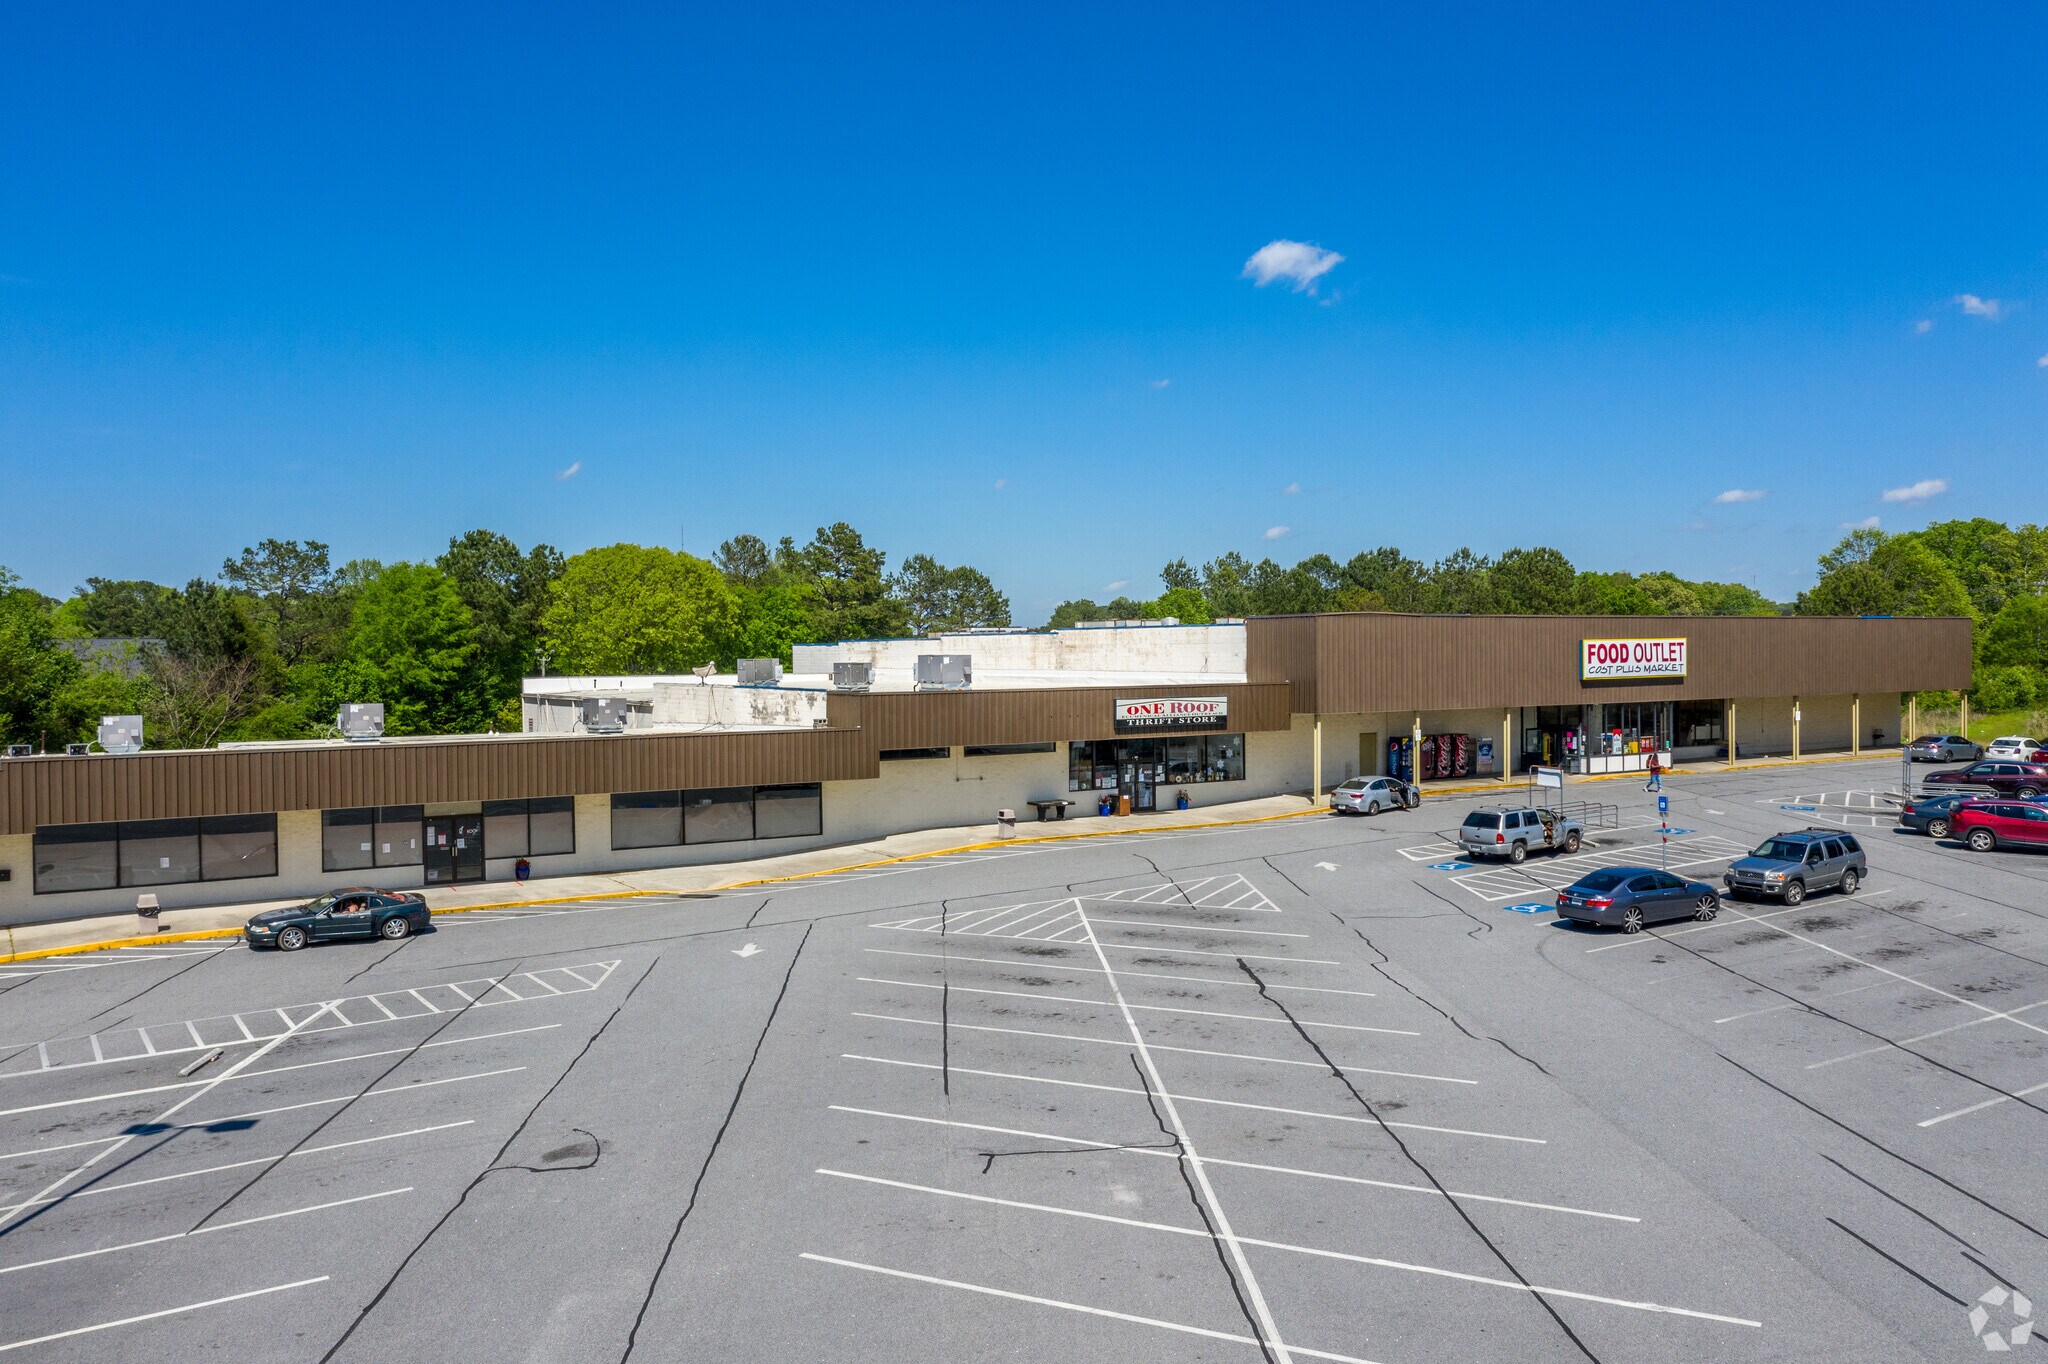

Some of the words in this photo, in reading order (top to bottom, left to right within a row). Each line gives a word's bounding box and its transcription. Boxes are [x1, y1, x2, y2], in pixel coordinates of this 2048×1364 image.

[1587, 643, 1630, 664] FOOD
[1633, 642, 1685, 663] OUTLET
[1588, 665, 1614, 675] COST
[1615, 665, 1642, 673] PLUS
[1643, 663, 1684, 674] MARKET
[1126, 703, 1165, 715] ONE
[1169, 702, 1220, 714] ROOF
[1126, 717, 1174, 726] THRIFT
[1178, 716, 1217, 724] STORE
